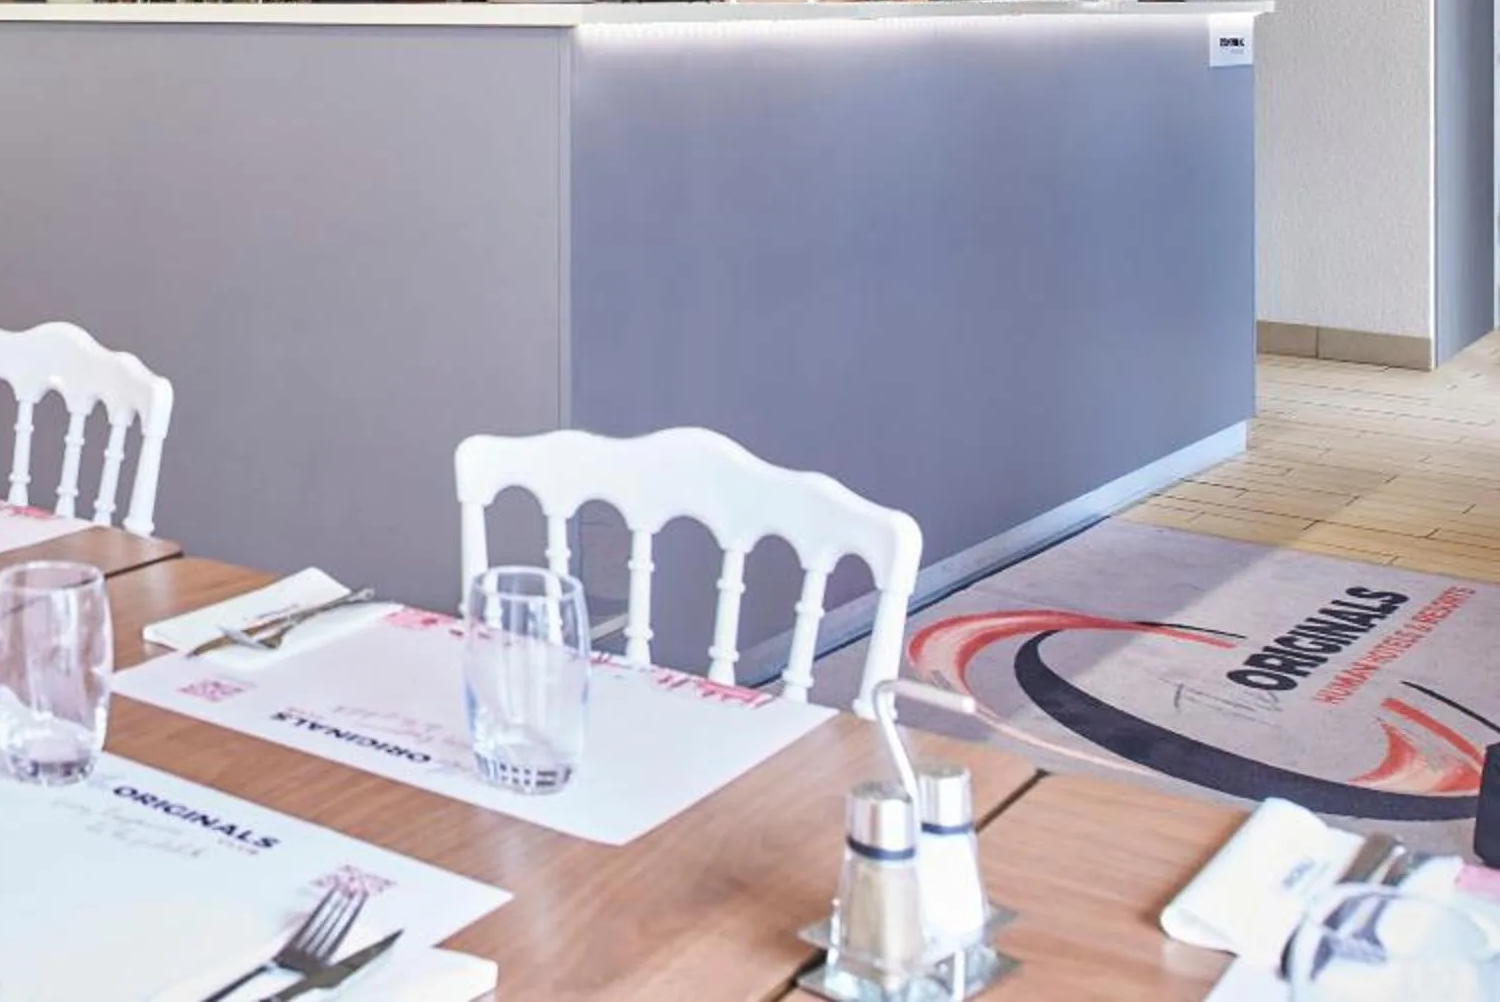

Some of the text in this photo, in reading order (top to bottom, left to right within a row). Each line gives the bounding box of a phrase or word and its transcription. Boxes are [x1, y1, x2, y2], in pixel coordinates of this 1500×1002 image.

[1226, 587, 1409, 691] ORIGINALS
[270, 711, 431, 763] ORIGINALS
[112, 785, 279, 850] ORIGINALS
